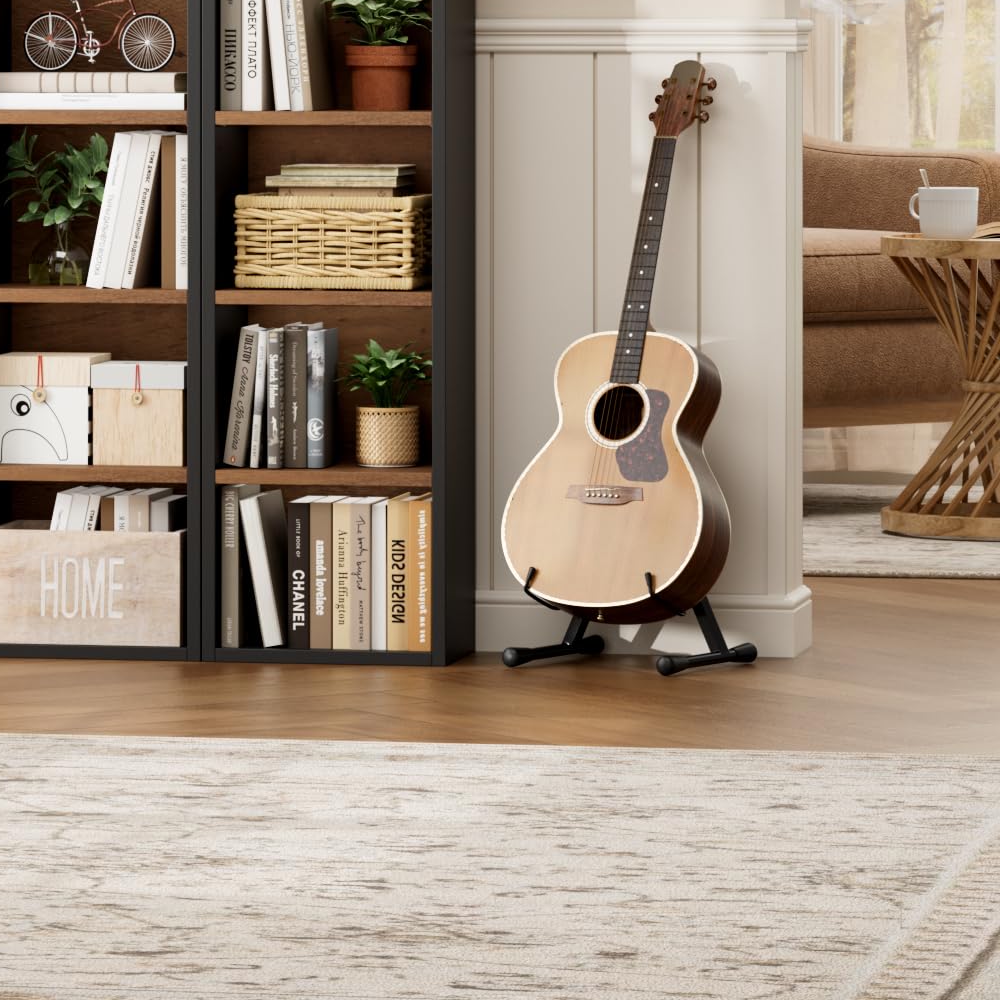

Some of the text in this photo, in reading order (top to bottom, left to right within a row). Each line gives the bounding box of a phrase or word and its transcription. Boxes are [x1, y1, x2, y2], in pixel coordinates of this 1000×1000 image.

[224, 29, 237, 91] ПИКАССО
[247, 41, 257, 79] ПЛАТО
[231, 334, 254, 450] TOLSTOY Anna Karenina
[269, 353, 279, 409] Sherlock Holmes
[224, 502, 235, 525] CHERRY
[356, 516, 366, 534] The
[40, 556, 125, 619] HOME
[292, 570, 305, 631] CHANEL
[315, 540, 327, 616] amanda lovelace
[336, 529, 348, 625] Arianna Huffington
